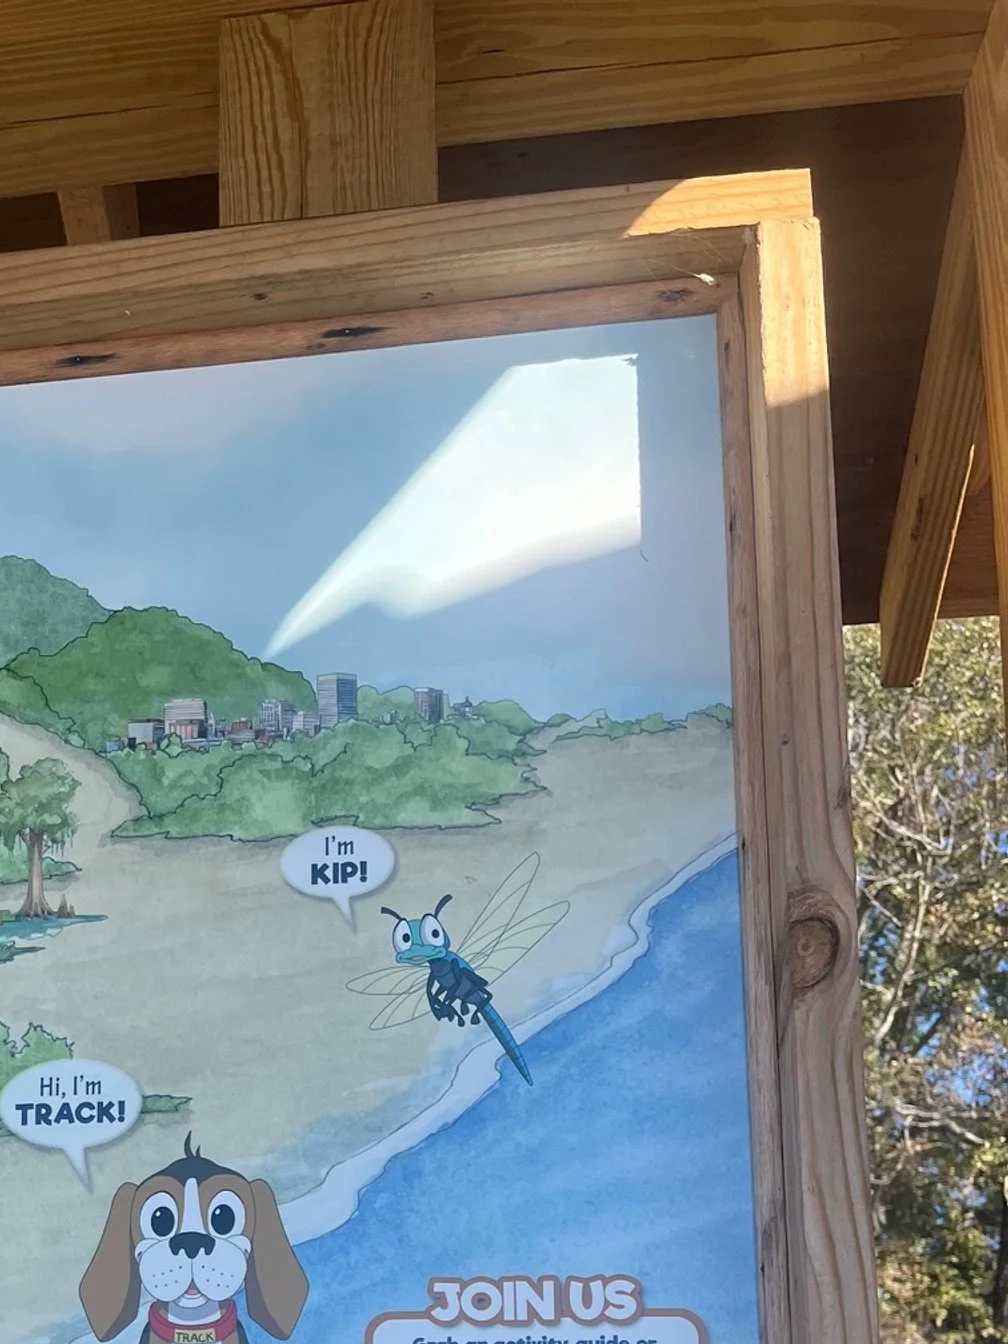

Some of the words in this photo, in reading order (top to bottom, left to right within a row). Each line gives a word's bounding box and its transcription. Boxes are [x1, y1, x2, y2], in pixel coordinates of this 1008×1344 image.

[325, 836, 354, 856] I'm
[311, 860, 368, 885] KIP!
[40, 1077, 67, 1098] Hi,
[74, 1076, 102, 1096] I'm
[16, 1100, 125, 1127] TRACK!
[430, 1279, 556, 1322] JOIN
[568, 1279, 639, 1321] US
[177, 1331, 215, 1344] TRACK
